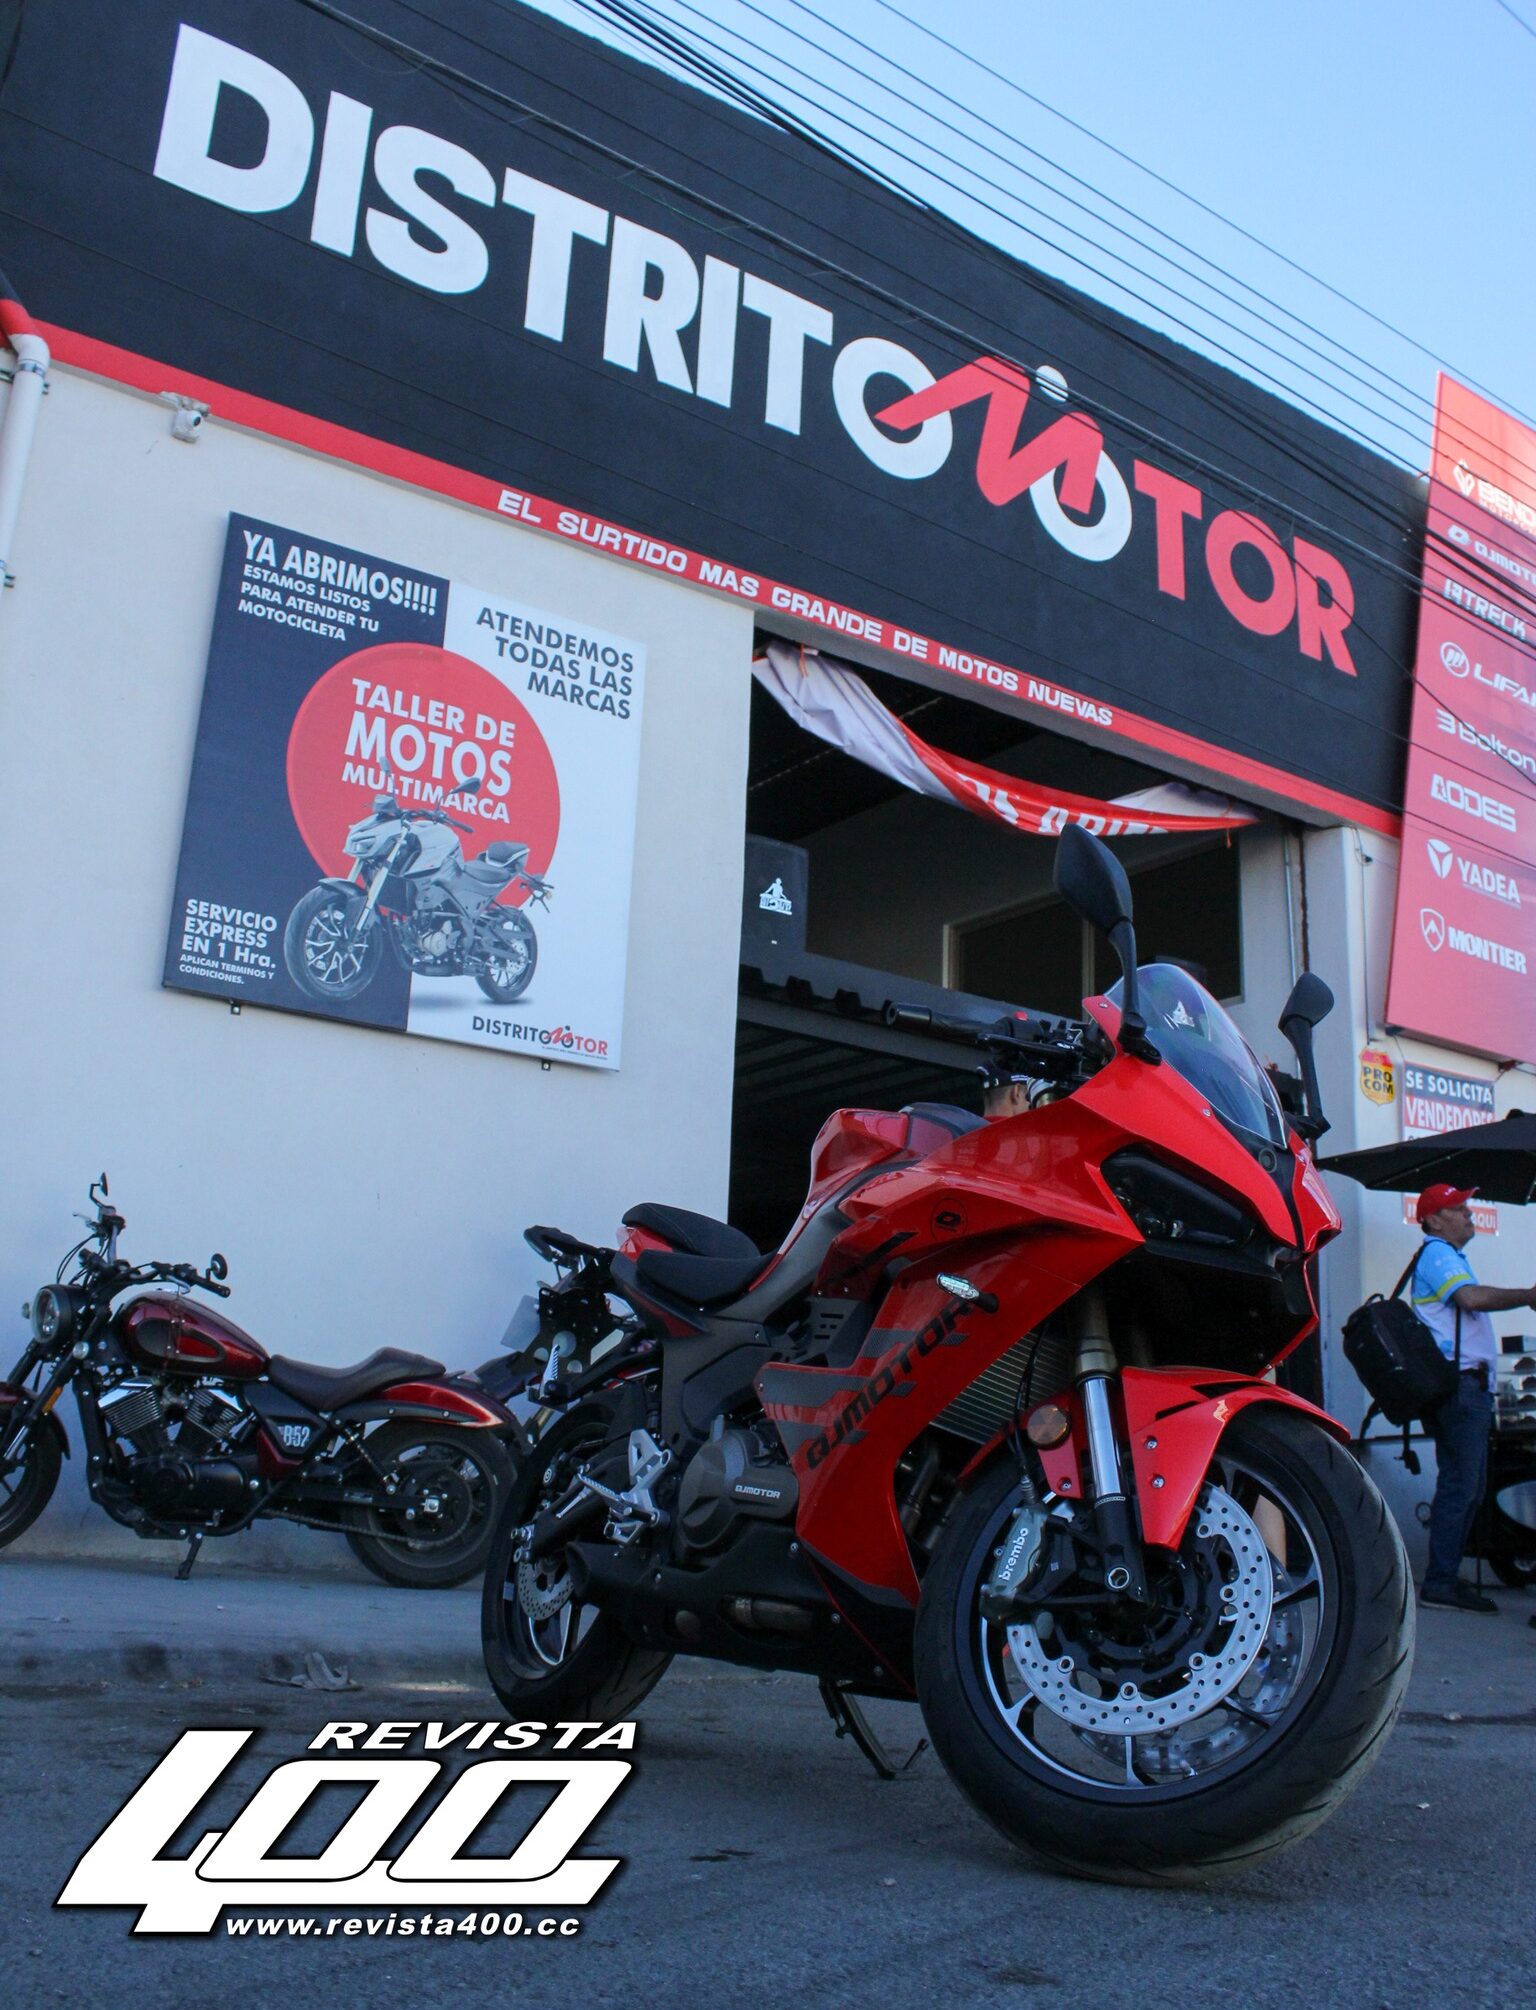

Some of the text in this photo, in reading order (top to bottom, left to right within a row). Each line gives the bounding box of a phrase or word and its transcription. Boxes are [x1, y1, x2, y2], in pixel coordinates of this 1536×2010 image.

[1478, 480, 1536, 530] BEND
[243, 530, 437, 616] YA ABRIMOS!!!!
[243, 563, 371, 612] ESTAMOS LISTOS
[238, 599, 347, 641] MOTOCICLETA
[241, 581, 379, 632] PARA ATENDER TU
[497, 489, 1113, 726] EL SURTIDO MAS GRANDE DE MOTOS NUEVAS
[476, 606, 634, 673] ATENDEMOS
[495, 635, 633, 696] TODAS LAS
[352, 678, 516, 748] TALLER DE
[527, 671, 631, 720] MARCAS
[344, 710, 512, 797] MOTOS
[341, 761, 510, 825] MULTIMARCA
[1457, 857, 1521, 904] YADEA
[184, 916, 267, 948] EXPRESS
[186, 898, 277, 932] SERVICIO
[179, 964, 245, 985] CONDICIONES.
[180, 954, 274, 980] APLICAN TERMINOS Y
[182, 934, 276, 968] EN 1 Hra.
[1448, 926, 1527, 975] MONTIER
[1363, 1066, 1393, 1083] PRO
[1363, 1079, 1394, 1096] COM
[1405, 1069, 1493, 1105] SE SOLICITA
[735, 1484, 781, 1499] QJMOTOR
[998, 1526, 1029, 1582] brembo
